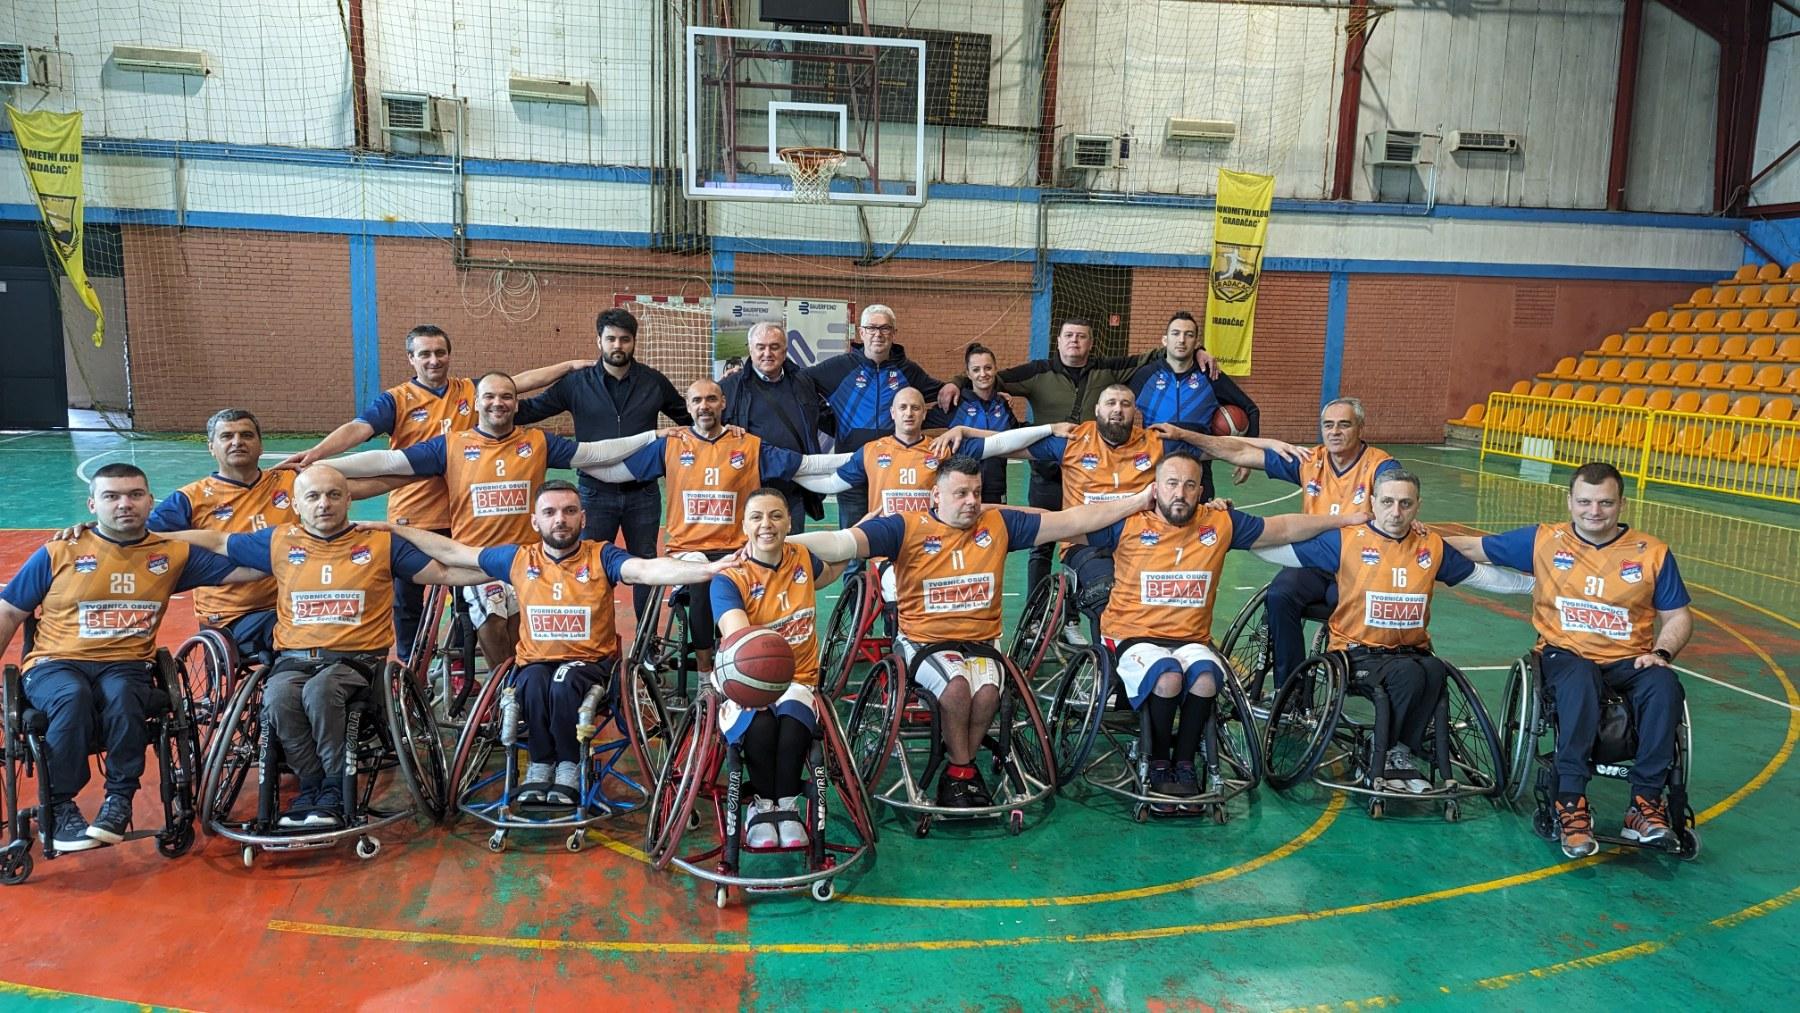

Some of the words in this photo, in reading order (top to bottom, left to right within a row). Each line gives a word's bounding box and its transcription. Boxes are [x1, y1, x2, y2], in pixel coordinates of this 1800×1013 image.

[496, 460, 506, 476] 2
[704, 468, 720, 486] 21
[899, 468, 916, 484] 20
[1112, 472, 1119, 488] 1
[478, 490, 525, 508] BEMA
[688, 500, 732, 515] BEMA
[888, 499, 928, 512] BEMA
[952, 550, 966, 570] 11
[1174, 546, 1184, 566] 7
[110, 572, 136, 594] 25
[321, 564, 332, 584] 6
[1391, 568, 1408, 588] 16
[928, 579, 966, 588] TVORNICA
[1148, 581, 1203, 598] BEMA
[1584, 576, 1604, 598] 31
[930, 584, 986, 602] BEMA
[297, 601, 355, 618] BEMA
[1372, 602, 1420, 620] BEMA
[1563, 607, 1624, 630] BEMA
[86, 612, 150, 628] BEMA
[532, 616, 583, 632] BEMA
